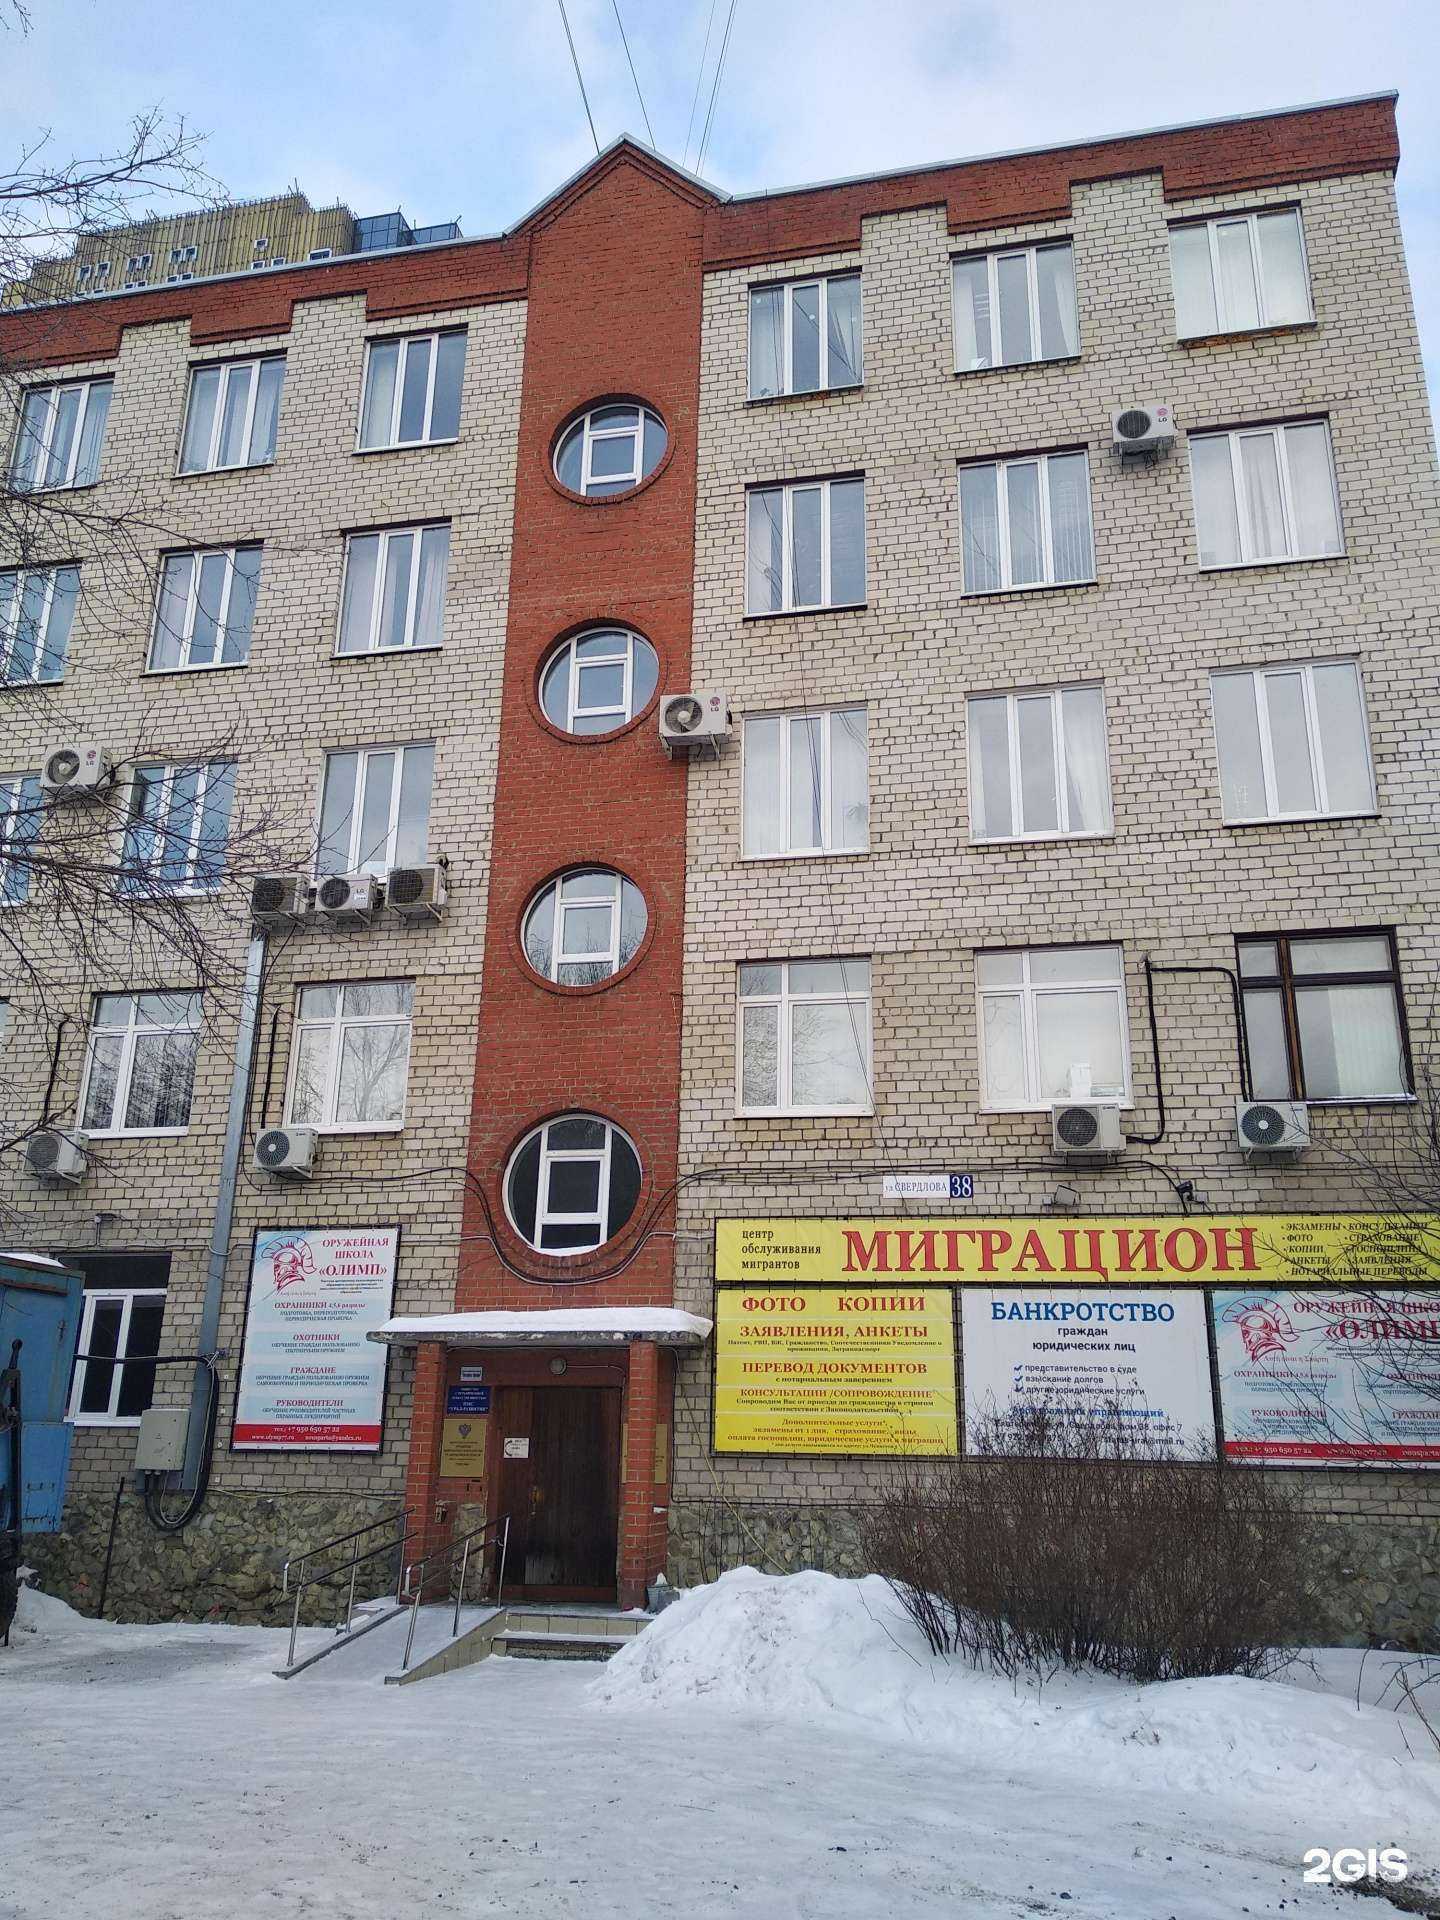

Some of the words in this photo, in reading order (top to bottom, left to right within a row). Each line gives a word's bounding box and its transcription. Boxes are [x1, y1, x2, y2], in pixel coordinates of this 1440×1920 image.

[894, 1182, 947, 1193] СВЕРДЛОВА
[951, 1175, 972, 1198] 38
[1286, 1223, 1341, 1231] ЭКЗАМЕНЫ
[741, 1230, 775, 1242] центр
[1286, 1234, 1314, 1242] ФОТО
[322, 1236, 390, 1248] ОРУЖЕЙНАЯ
[335, 1250, 374, 1259] ШКОЛА
[741, 1243, 822, 1256] обслуживания
[841, 1226, 1263, 1282] МИГРАЦИОН
[1289, 1245, 1324, 1253] КОПИИ
[319, 1264, 388, 1276] «ОЛИМП»
[741, 1259, 801, 1271] мигрантов
[741, 1296, 806, 1313] ФОТО
[837, 1296, 926, 1312] КОПИИ
[991, 1302, 1175, 1322] БАНКРОТСТВО
[293, 1333, 341, 1341] ОХОТНИКИ
[740, 1326, 851, 1340] ЗАЯВЛЕНИЯ,
[854, 1326, 928, 1338] АНКЕТЫ
[1057, 1326, 1109, 1338] граждан
[1032, 1341, 1111, 1352] юридических
[1113, 1342, 1136, 1353] лиц
[743, 1362, 815, 1375] ПЕРЕВОД
[817, 1362, 928, 1375] ДОКУМЕНТОВ
[1024, 1364, 1108, 1374] представительство
[1117, 1366, 1137, 1375] суде
[1025, 1375, 1073, 1383] взыскание
[1073, 1377, 1104, 1385] долгов
[740, 1389, 828, 1398] КОНСУЛЬТАЦИИ
[829, 1389, 932, 1399] /СОПРОВОЖДЕНИЕ
[1025, 1386, 1056, 1395] другие
[1056, 1387, 1115, 1396] юридические
[1115, 1388, 1145, 1397] услуги
[276, 1399, 345, 1407] РУКОВОДИТЕЛИ
[782, 1418, 854, 1426] Дополнительные
[1153, 1423, 1175, 1432] офис
[1279, 1448, 1292, 1456] 650
